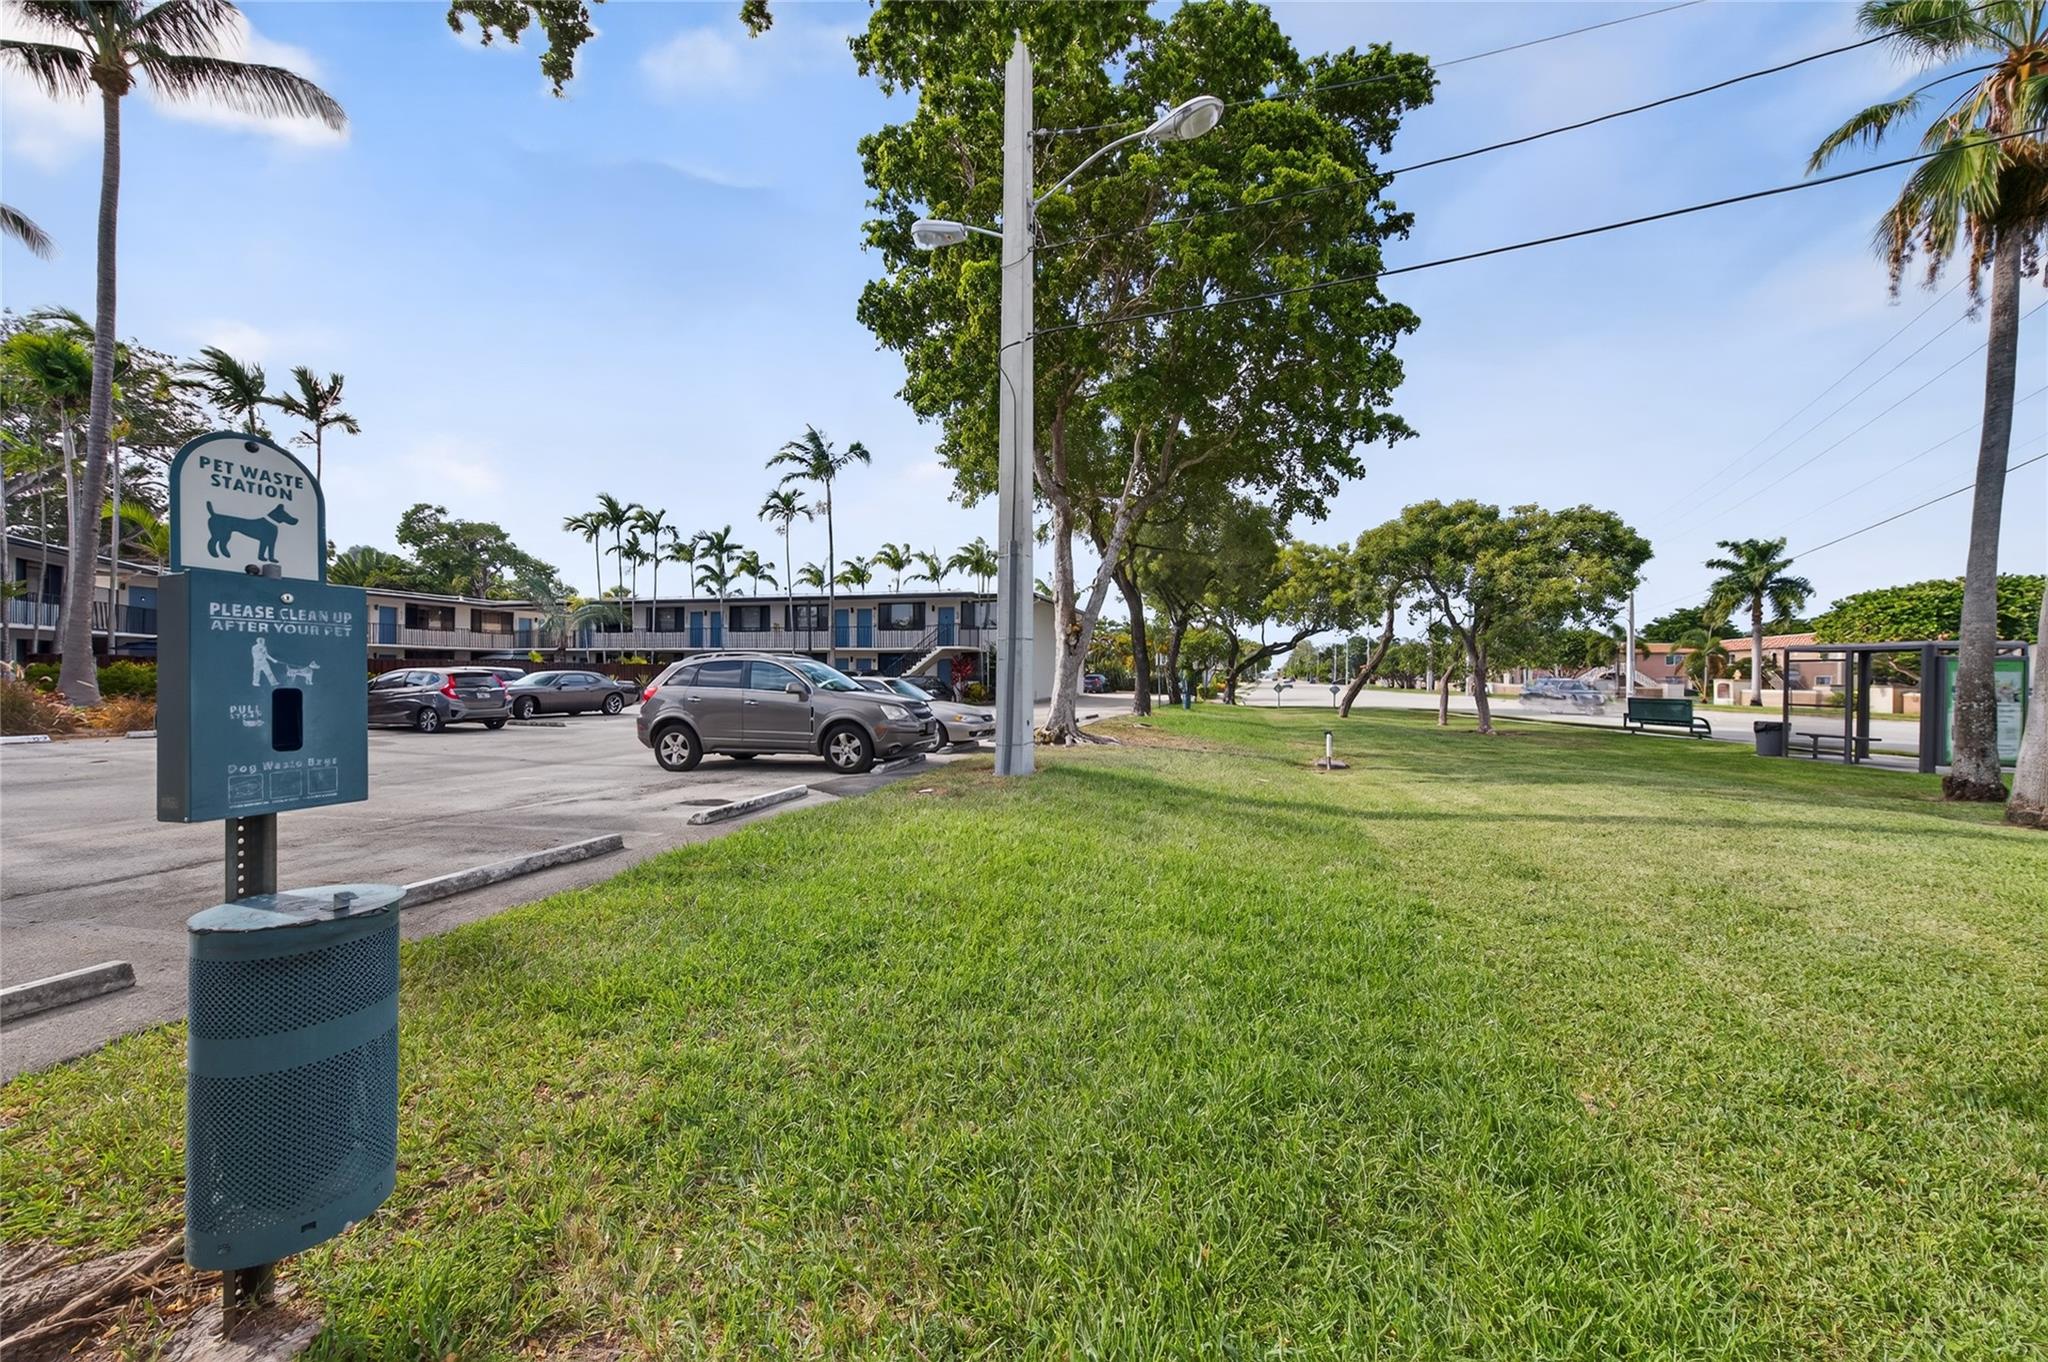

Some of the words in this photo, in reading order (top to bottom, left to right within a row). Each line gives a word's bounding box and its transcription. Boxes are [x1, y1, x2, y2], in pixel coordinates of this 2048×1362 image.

[200, 456, 234, 474] PET
[241, 465, 303, 489] WASTE
[211, 474, 292, 501] STATION
[210, 602, 274, 619] PLEASE
[280, 608, 328, 622] CLEAN
[333, 612, 352, 624] UP
[211, 620, 268, 632] AFTER
[274, 623, 319, 635] YOUR
[324, 625, 352, 637] PET
[228, 764, 257, 774] Dog
